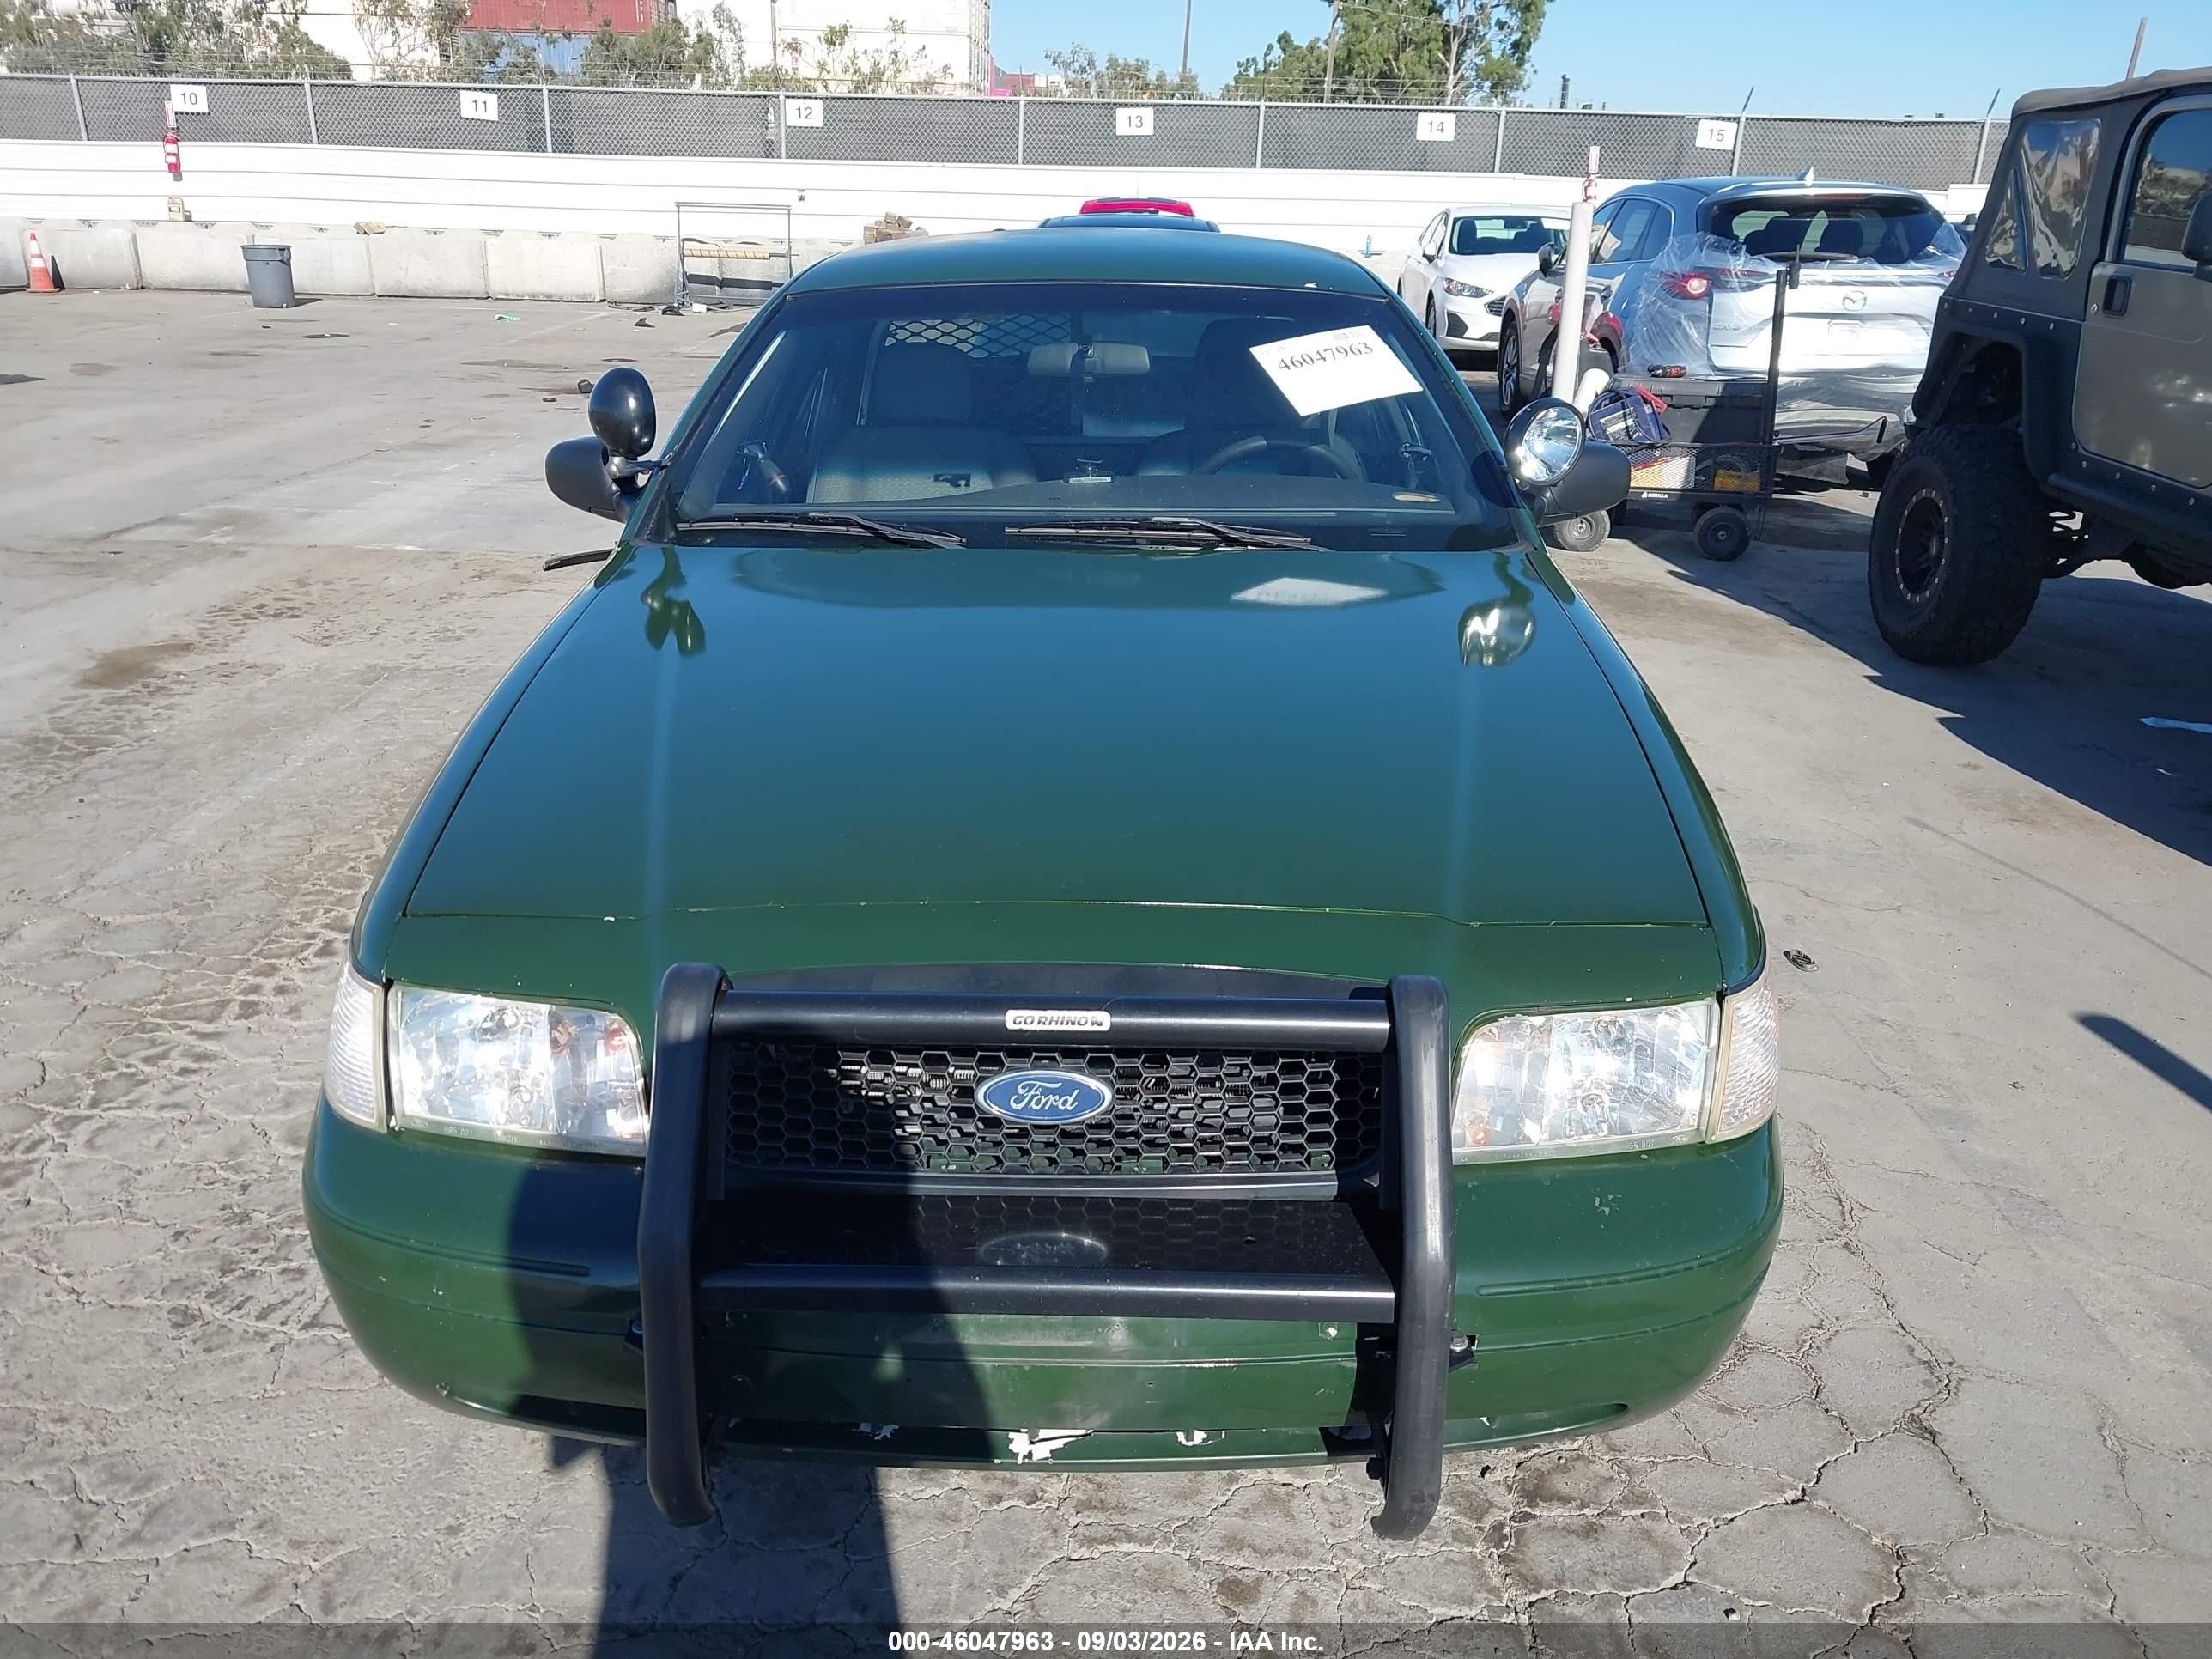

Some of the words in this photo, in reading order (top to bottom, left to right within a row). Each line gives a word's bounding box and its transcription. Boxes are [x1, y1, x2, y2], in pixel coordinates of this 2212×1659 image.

[180, 92, 198, 106] 10
[471, 99, 487, 112] 11
[795, 106, 813, 119] 12
[1127, 115, 1143, 128] 13
[1429, 121, 1444, 133] 14
[1709, 129, 1725, 142] 15
[1279, 342, 1374, 371] 46047963
[1009, 1080, 1079, 1111] Ford
